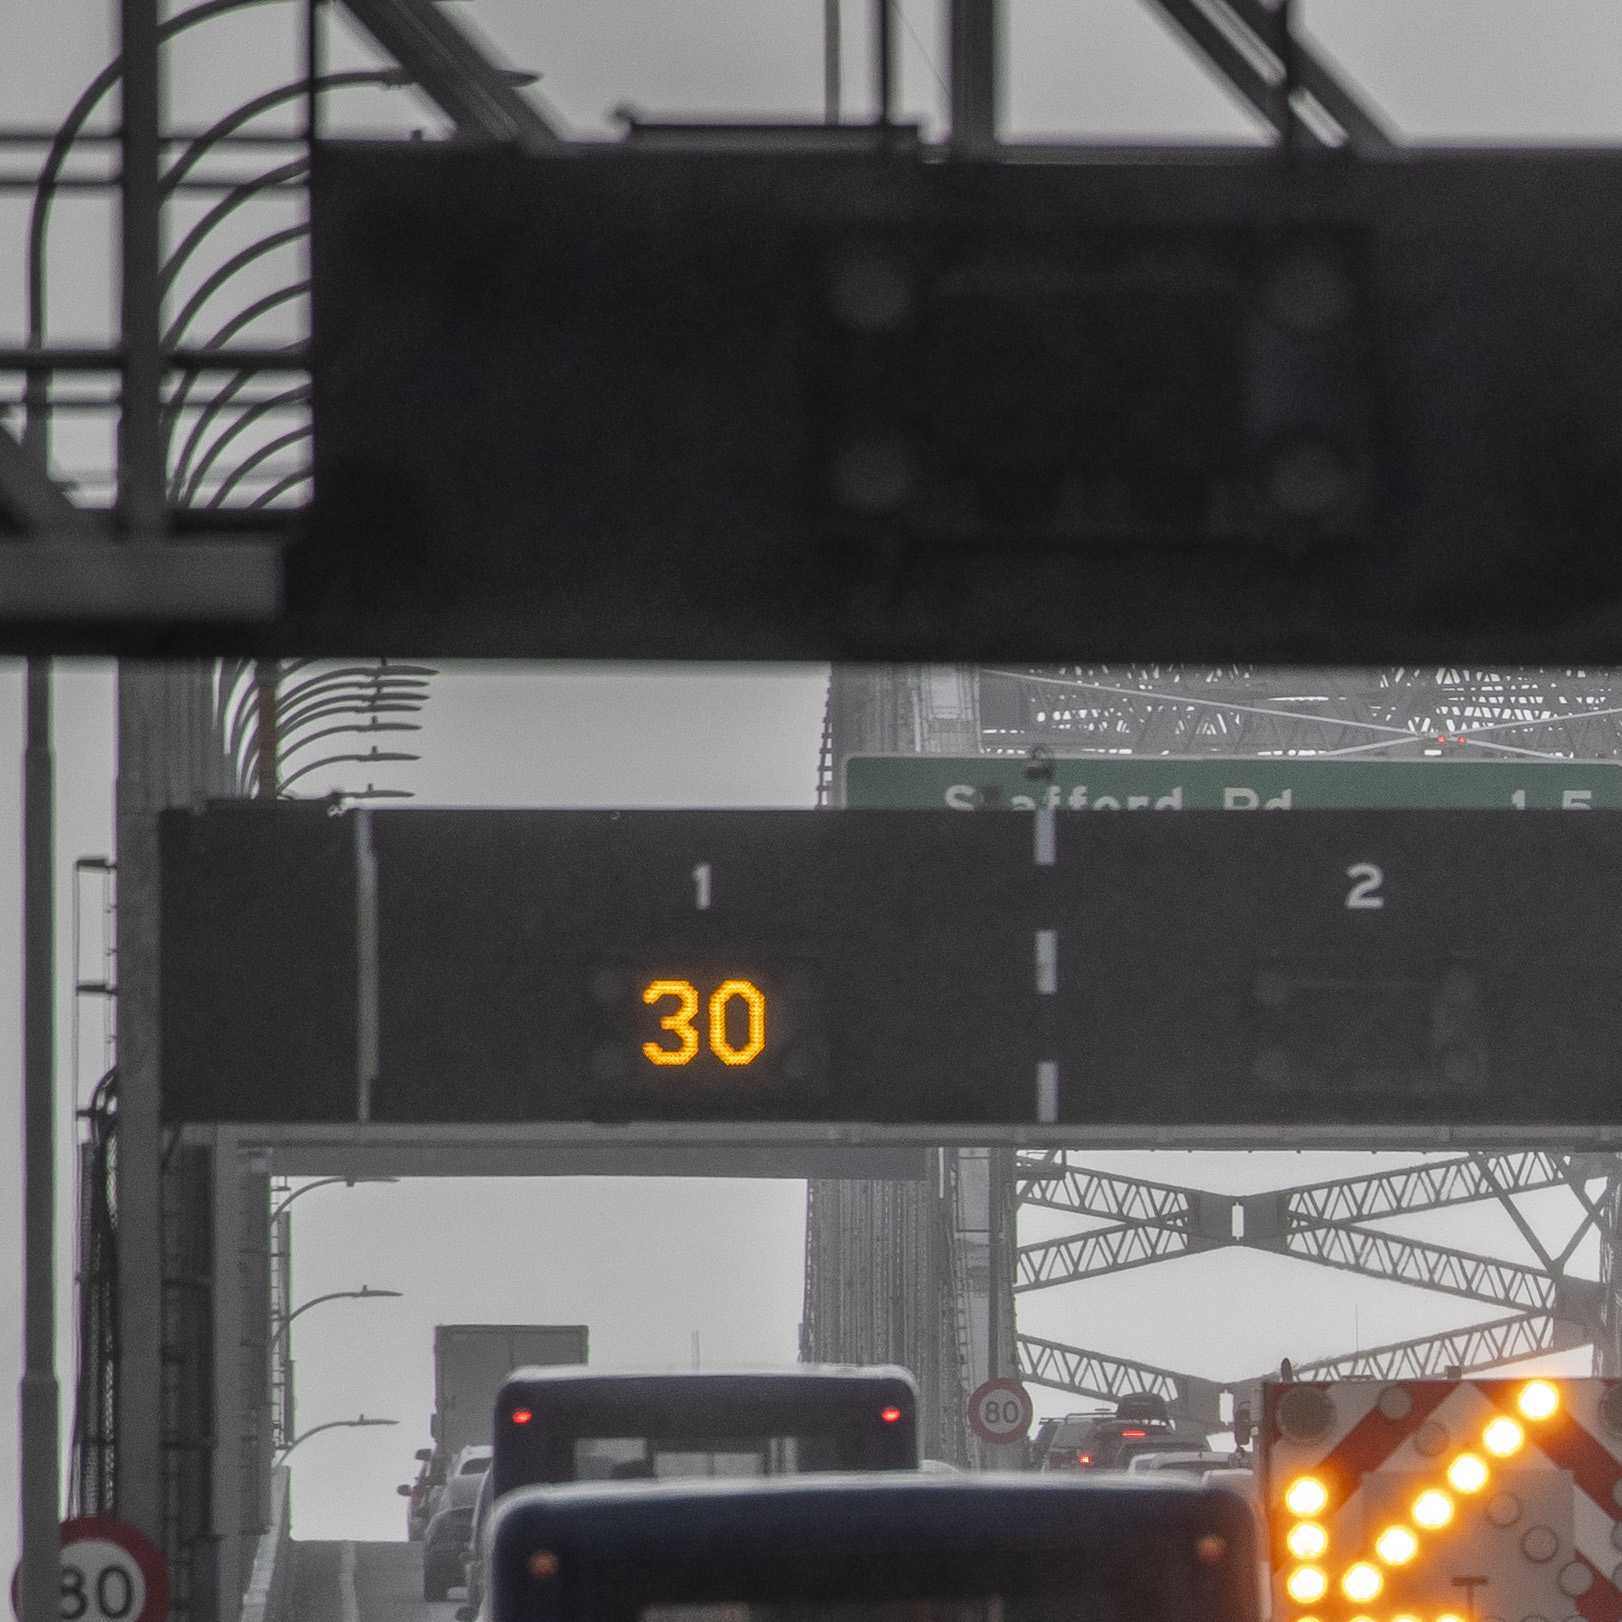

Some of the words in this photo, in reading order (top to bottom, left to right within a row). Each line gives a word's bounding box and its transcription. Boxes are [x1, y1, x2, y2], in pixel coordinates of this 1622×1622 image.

[692, 863, 713, 910] 1
[1346, 863, 1385, 910] 2
[641, 979, 767, 1066] 30
[985, 1401, 1018, 1423] 80
[59, 1564, 134, 1620] 80
